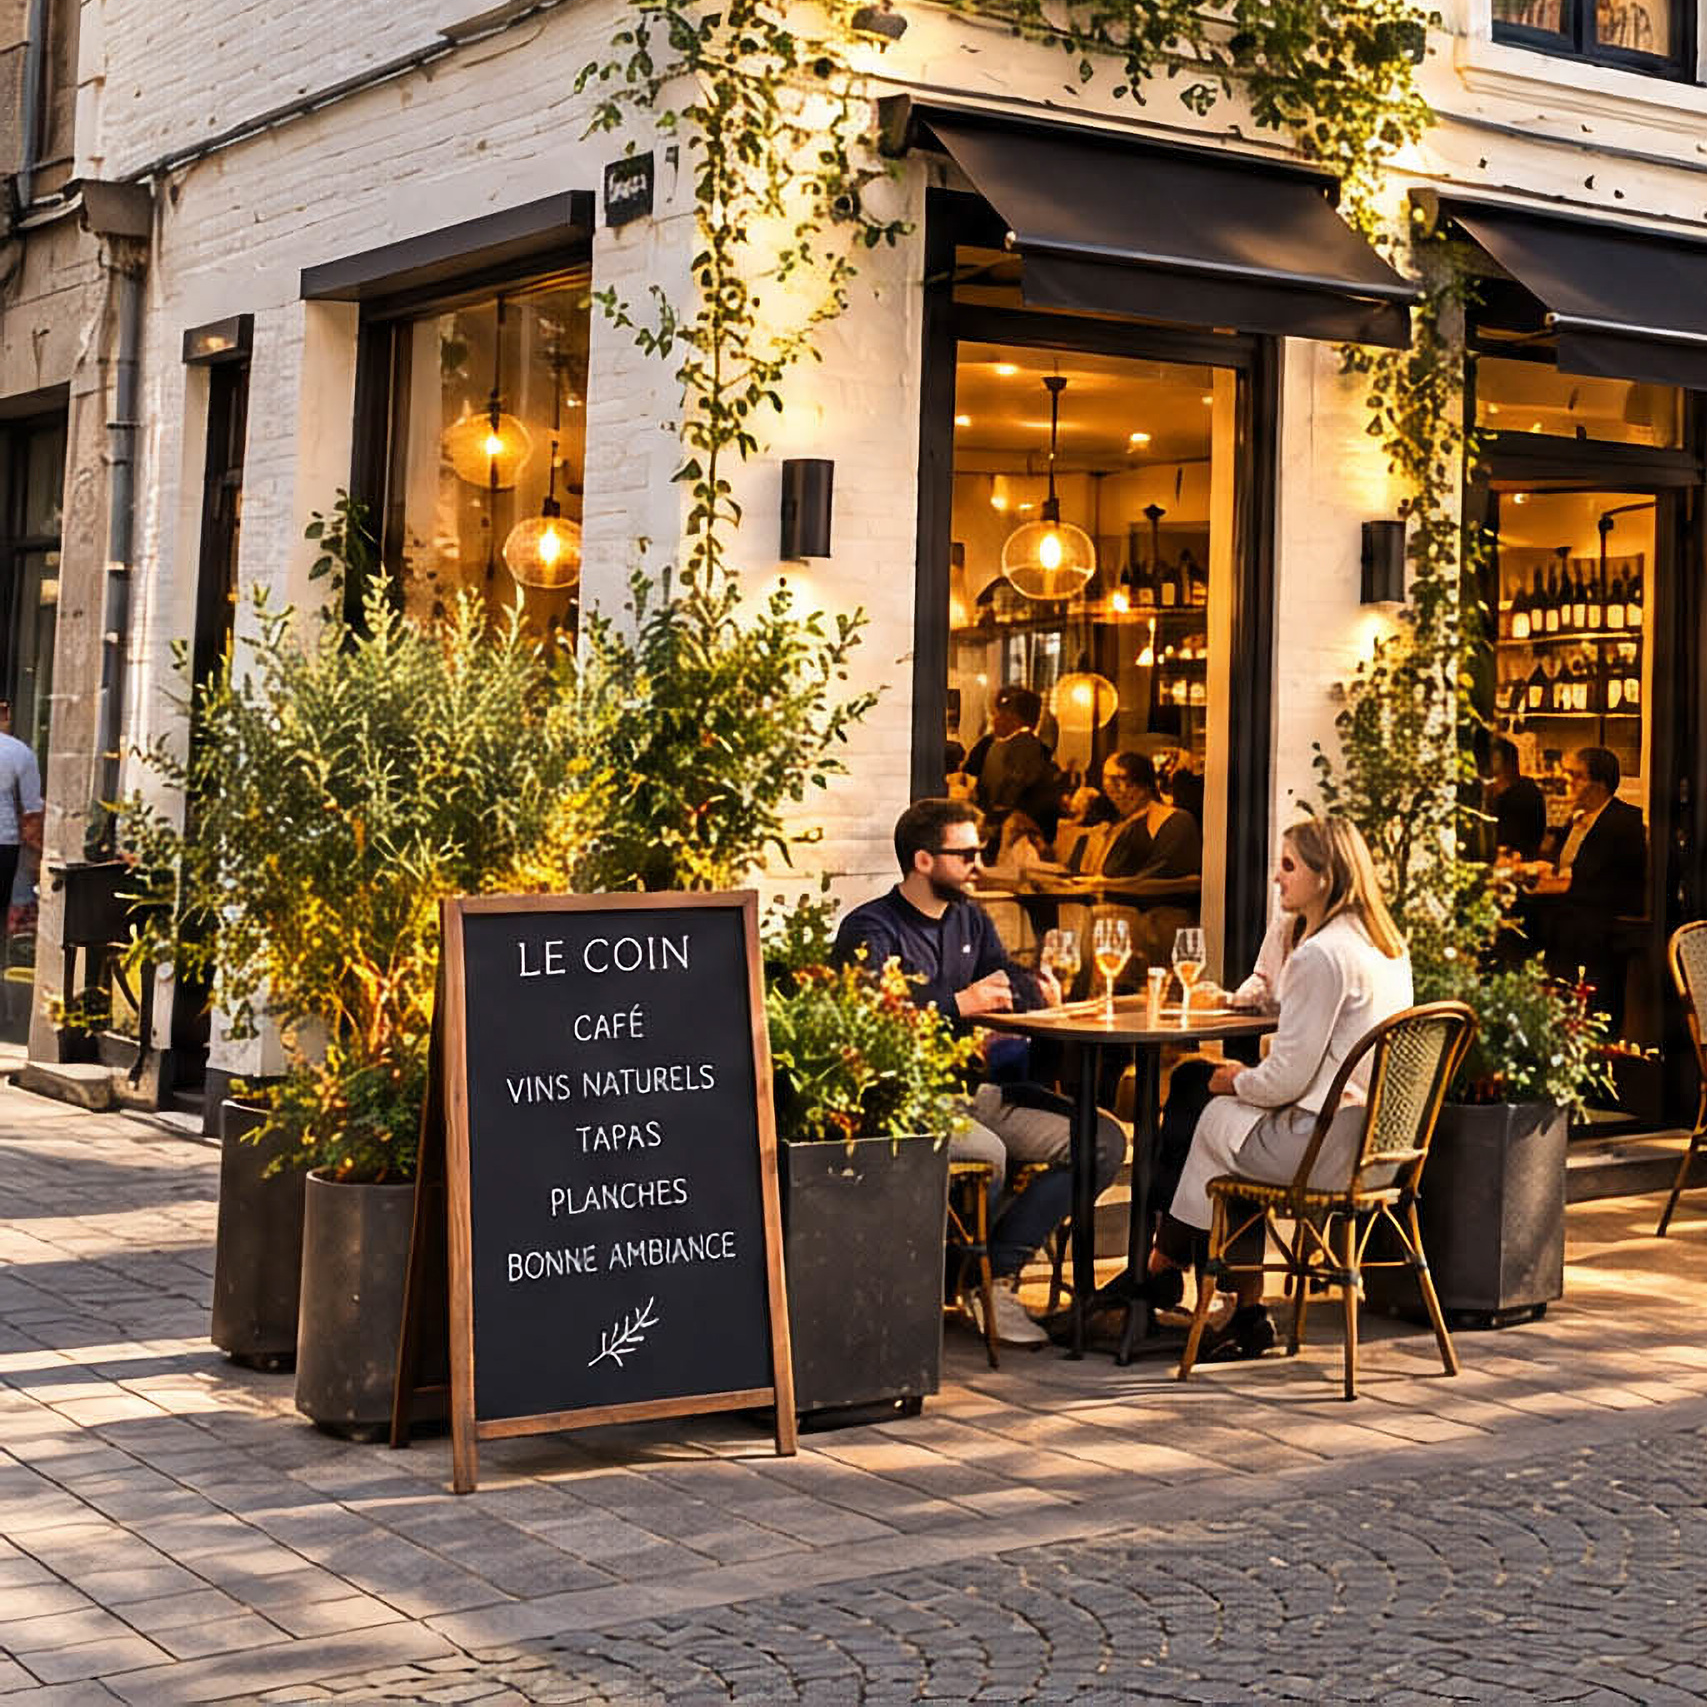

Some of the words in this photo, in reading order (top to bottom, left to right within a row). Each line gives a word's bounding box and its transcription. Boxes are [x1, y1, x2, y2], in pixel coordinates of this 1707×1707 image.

[518, 940, 566, 977] LE
[583, 934, 689, 973] COIN
[573, 1003, 644, 1042] CAFÉ
[506, 1074, 571, 1104] VINS
[583, 1064, 715, 1098] NATURELS
[575, 1120, 662, 1153] TAPAS
[551, 1178, 688, 1217] PLANCHES
[507, 1244, 598, 1282] BONNE
[608, 1231, 736, 1271] AMBIANCE
